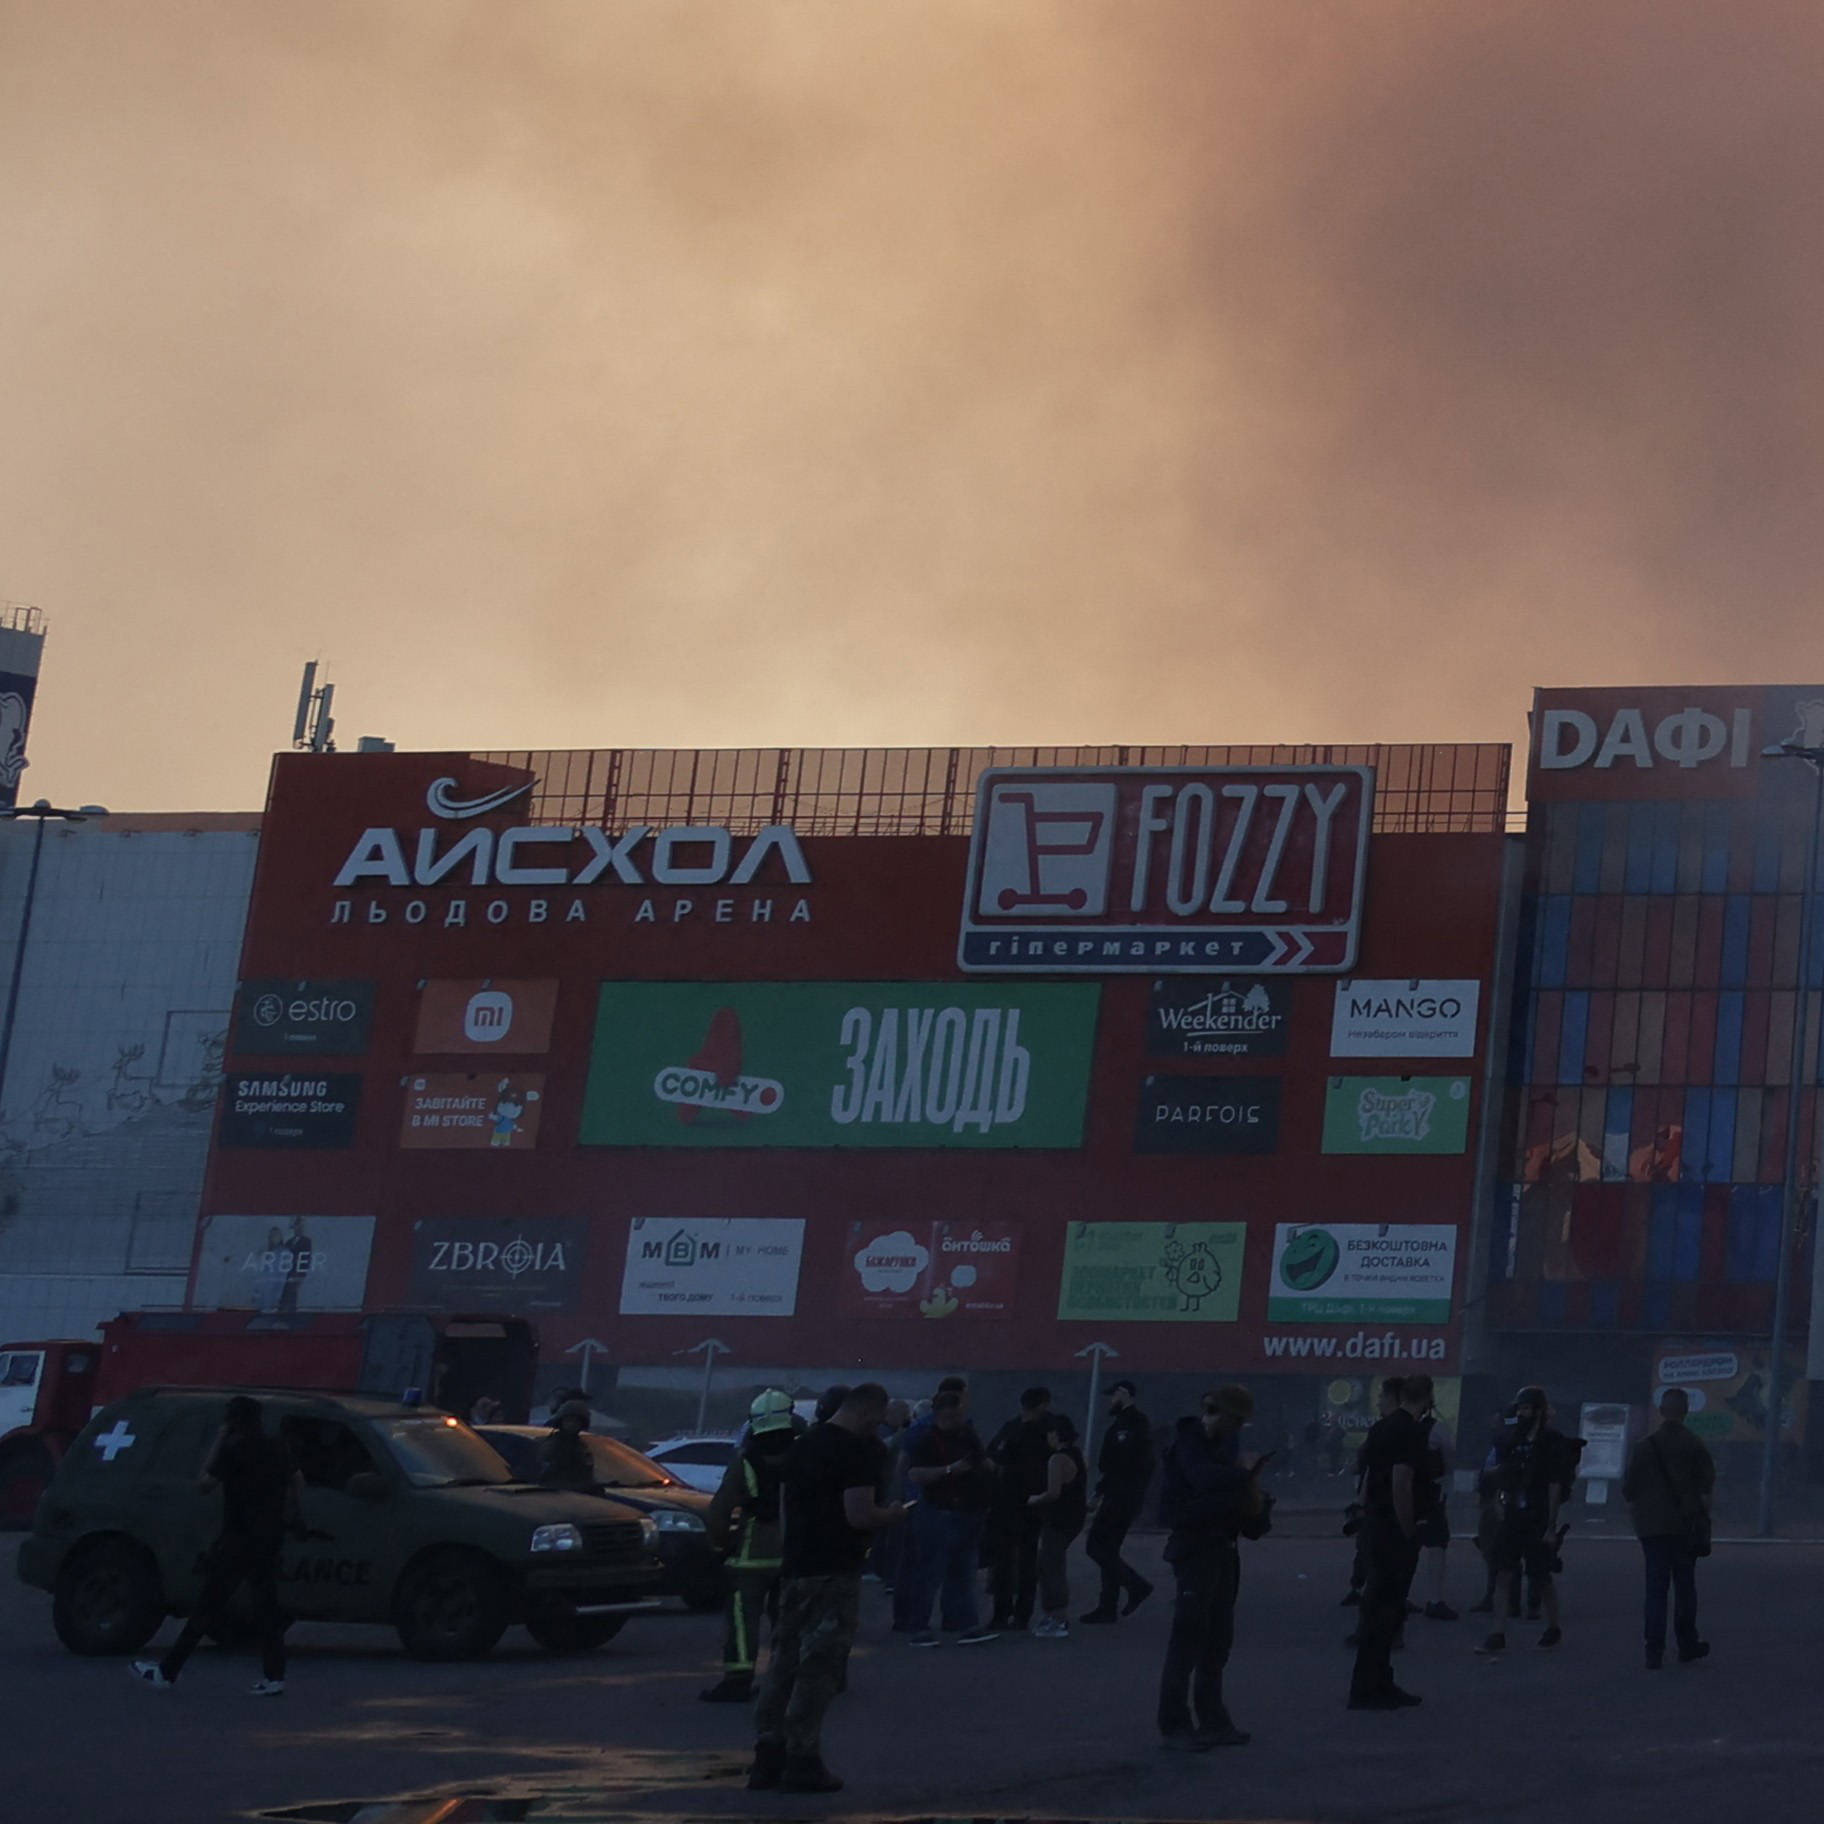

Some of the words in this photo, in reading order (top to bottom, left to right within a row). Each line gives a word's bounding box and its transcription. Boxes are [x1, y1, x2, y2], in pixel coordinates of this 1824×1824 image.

[1130, 782, 1350, 916] FOZZY
[330, 898, 588, 928] ЛЬОДОВА
[635, 898, 812, 924] АРЕНА
[988, 933, 1246, 958] гіпермаркет
[286, 995, 357, 1023] estro
[1158, 996, 1283, 1032] Weekender
[1349, 996, 1462, 1020] MANGO
[1347, 1029, 1405, 1040] Незабаром
[1408, 1029, 1459, 1040] відкриття
[1183, 1040, 1202, 1054] 1-й
[1204, 1042, 1249, 1055] поверх
[830, 1004, 1031, 1133] ЗАХОДЬ
[237, 1079, 328, 1097] SAMSUNG
[661, 1070, 760, 1106] COMFY
[234, 1099, 308, 1115] Experience
[310, 1099, 346, 1114] Store
[414, 1094, 488, 1111] ЗАВІТАЙТЕ
[1361, 1089, 1413, 1113] Super
[443, 1114, 486, 1128] STORE
[1154, 1104, 1261, 1124] PARFOIS
[757, 1245, 793, 1257] HOME
[1346, 1239, 1449, 1253] БЕЗКОШТОВНА
[239, 1250, 329, 1274] ARBER
[1360, 1256, 1431, 1270] ДОСТАВКА
[1264, 1331, 1447, 1361] www.dafi.ua
